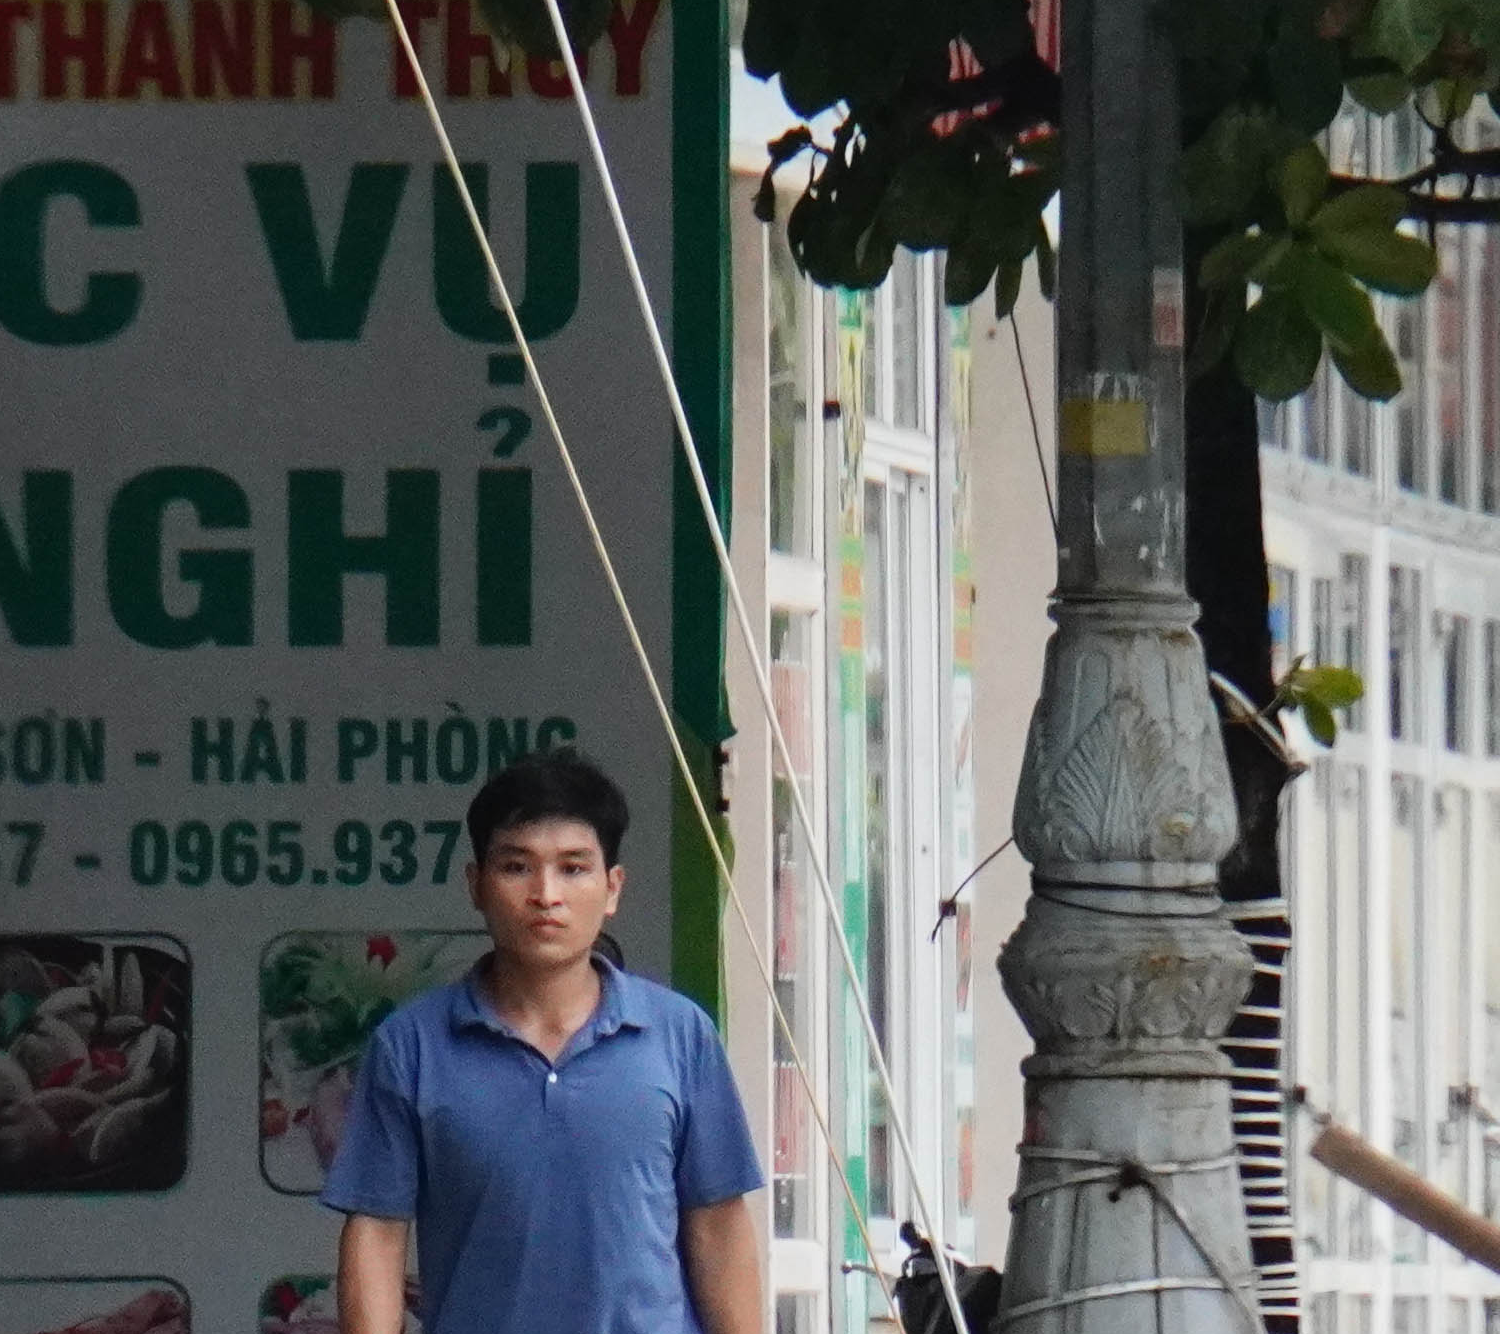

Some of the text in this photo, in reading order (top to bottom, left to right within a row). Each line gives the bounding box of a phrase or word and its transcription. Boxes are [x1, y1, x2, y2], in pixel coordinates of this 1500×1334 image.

[243, 161, 583, 386] VỤ
[189, 698, 308, 785] HẢI
[129, 820, 464, 890] 0965.937
